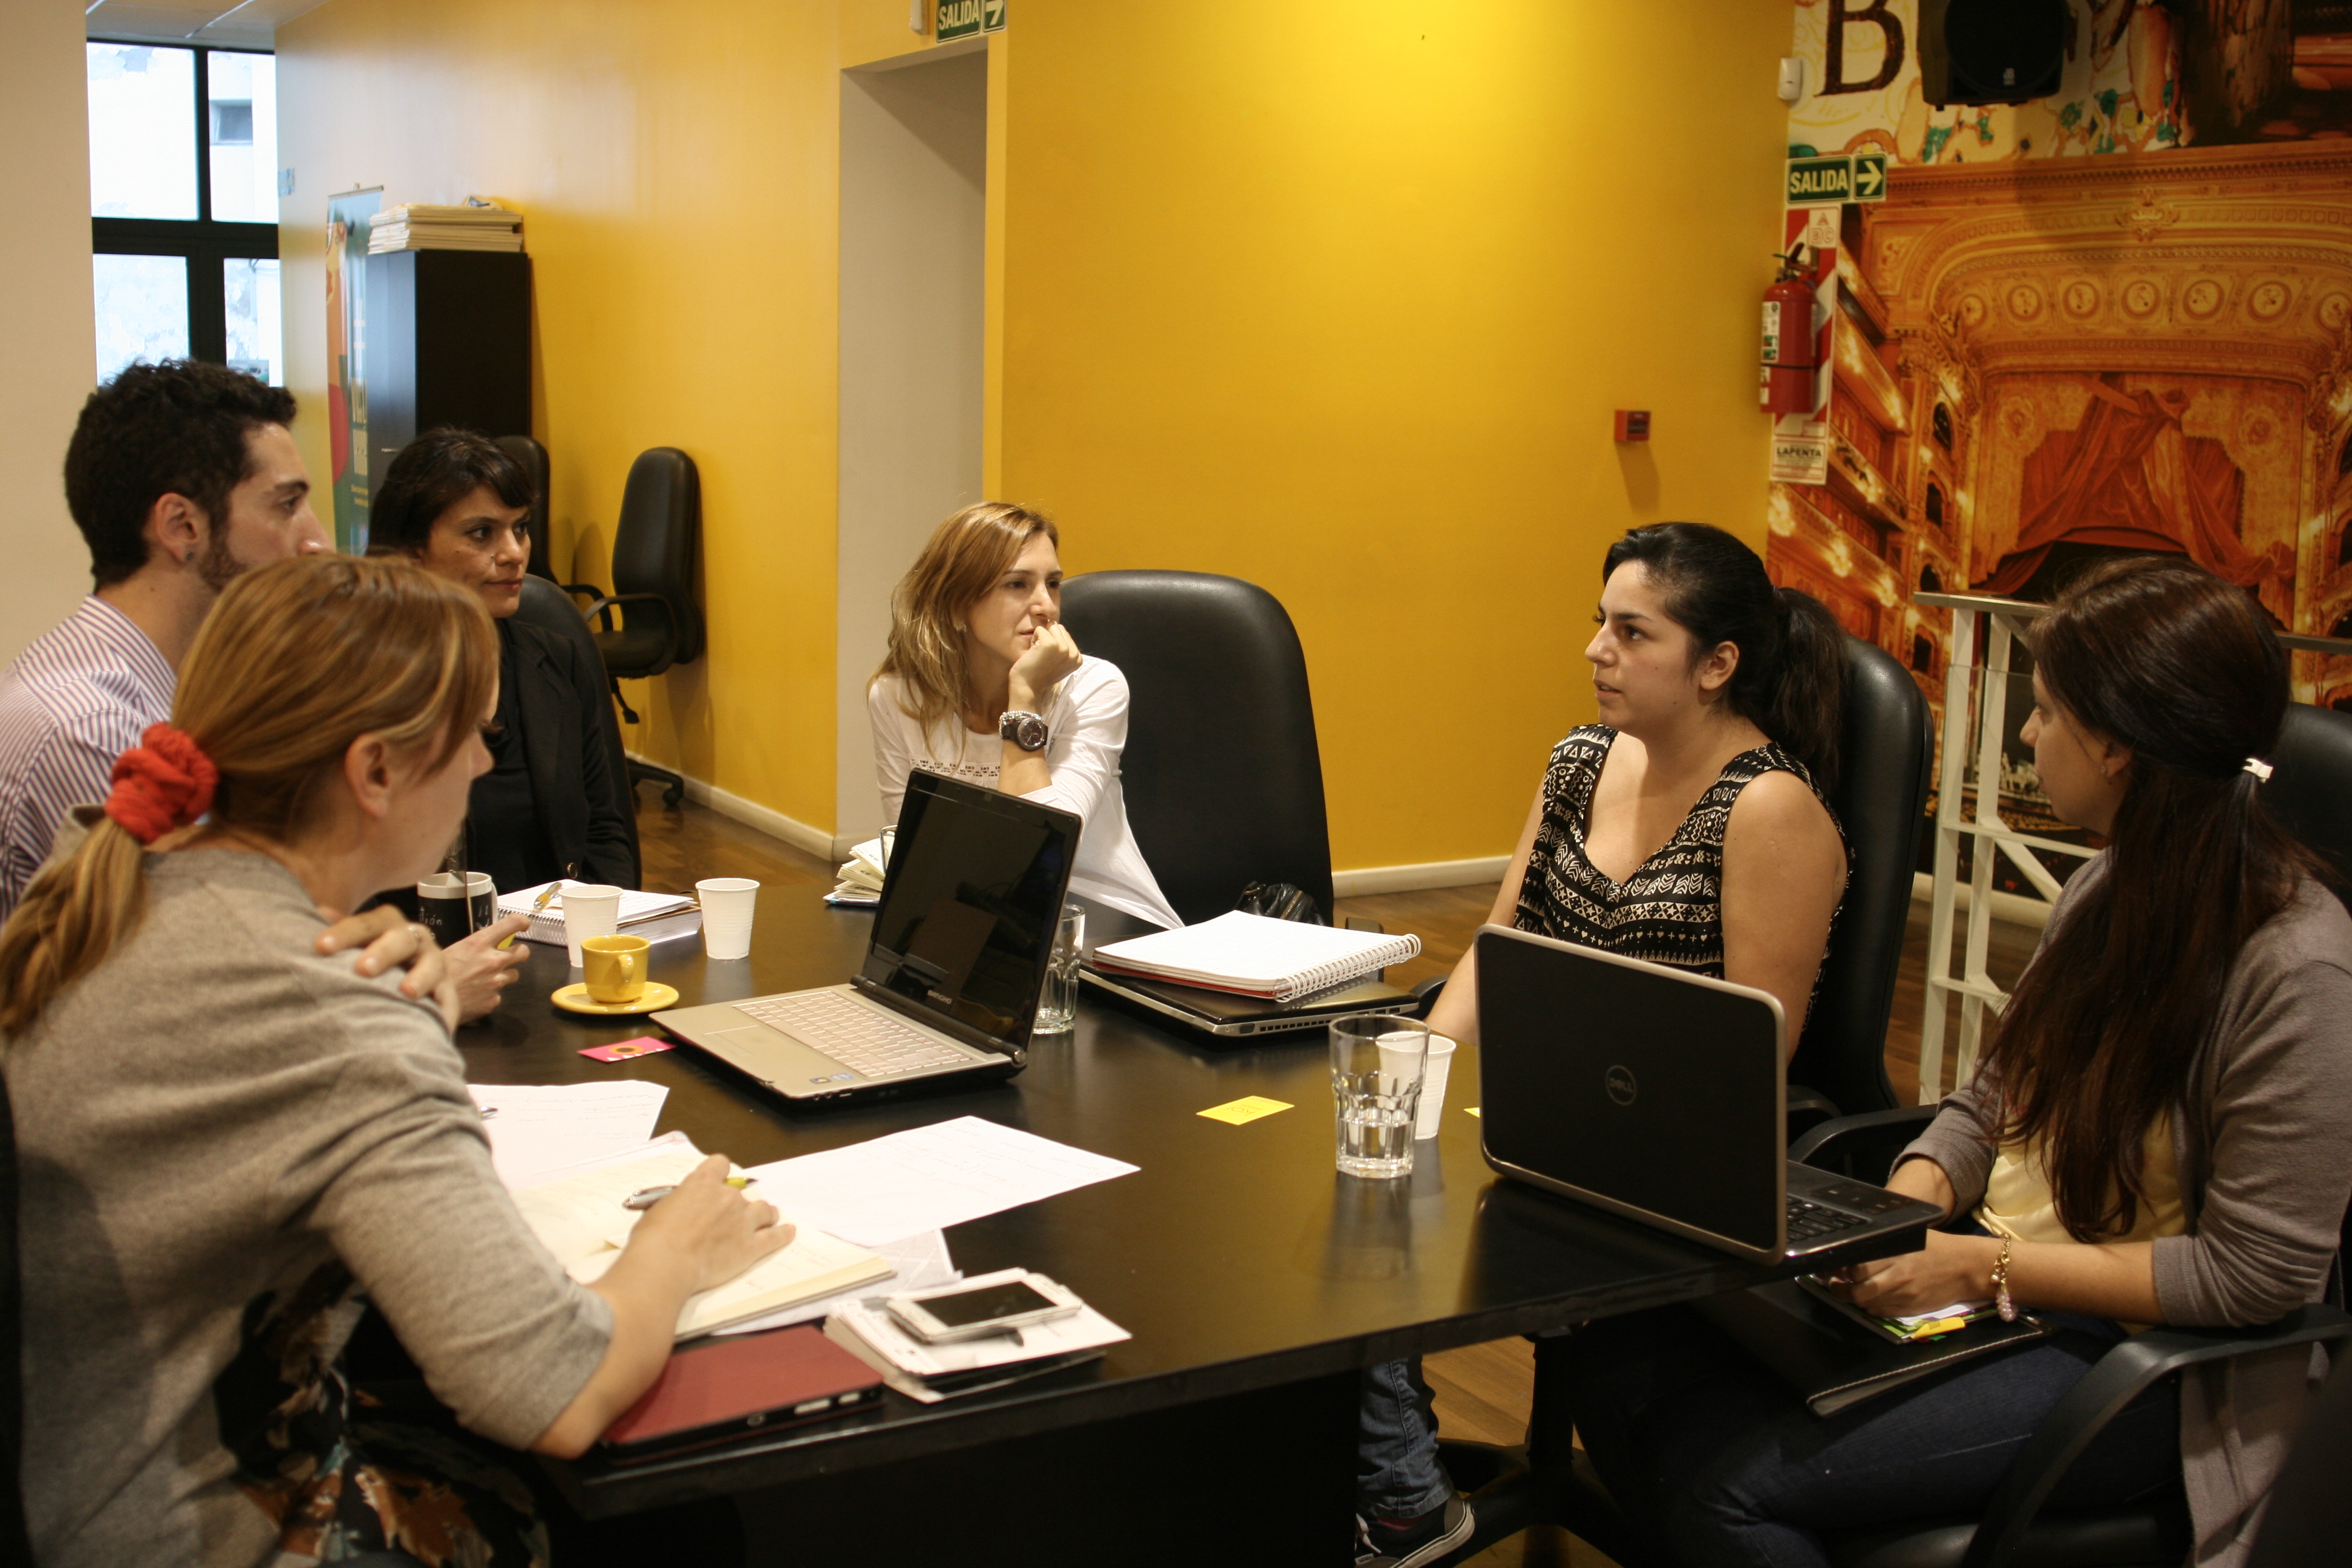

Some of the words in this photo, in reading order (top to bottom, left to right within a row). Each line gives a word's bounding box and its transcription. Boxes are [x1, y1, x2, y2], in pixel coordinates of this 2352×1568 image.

[938, 0, 979, 30] SALIDA
[1789, 168, 1849, 194] SALIDA
[1777, 446, 1821, 457] LAPENTA
[1609, 1077, 1634, 1094] DELL
